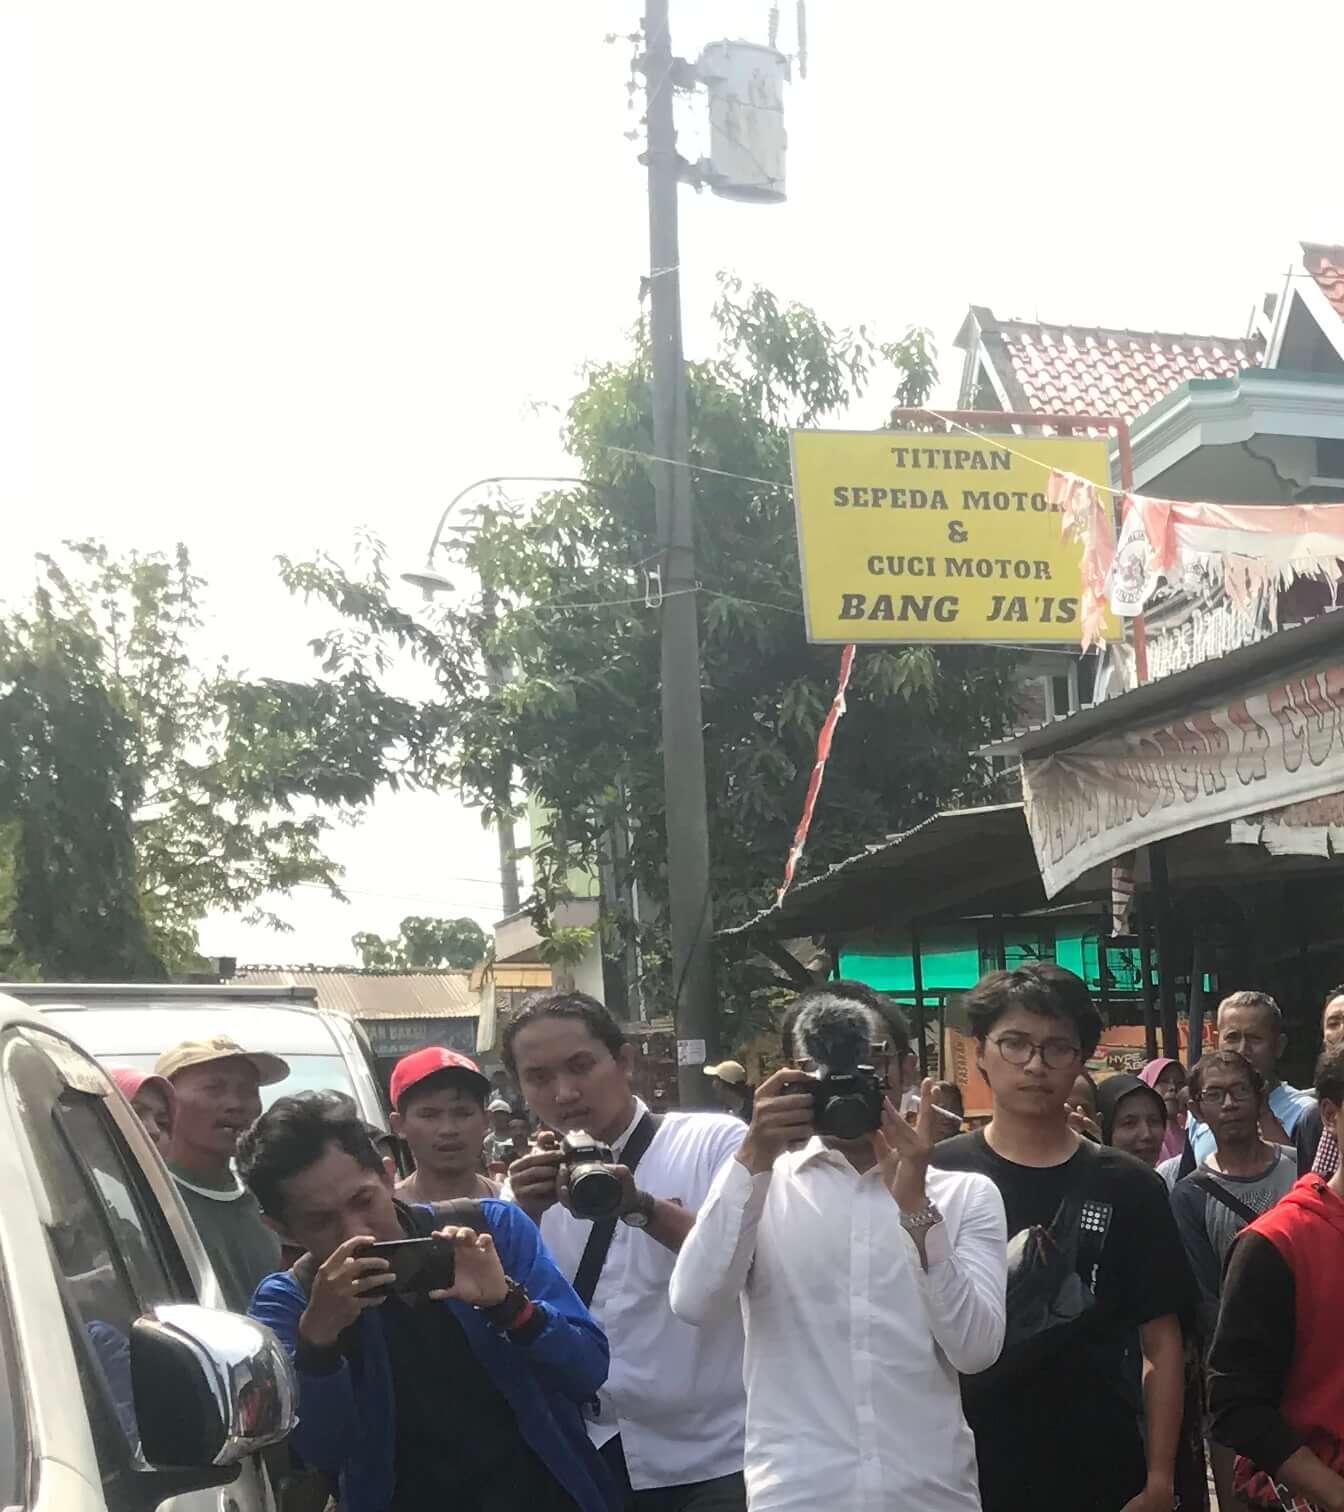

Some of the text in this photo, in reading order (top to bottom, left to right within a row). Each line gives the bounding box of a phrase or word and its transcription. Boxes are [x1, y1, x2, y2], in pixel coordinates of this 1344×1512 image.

[891, 447, 1012, 471] TITIPAN
[833, 486, 947, 511] SEPEDA
[946, 519, 969, 544] &
[866, 555, 1052, 580] CUCI MOTOR
[838, 594, 1079, 624] BANG JA'IS
[1108, 1052, 1142, 1064] HYPE
